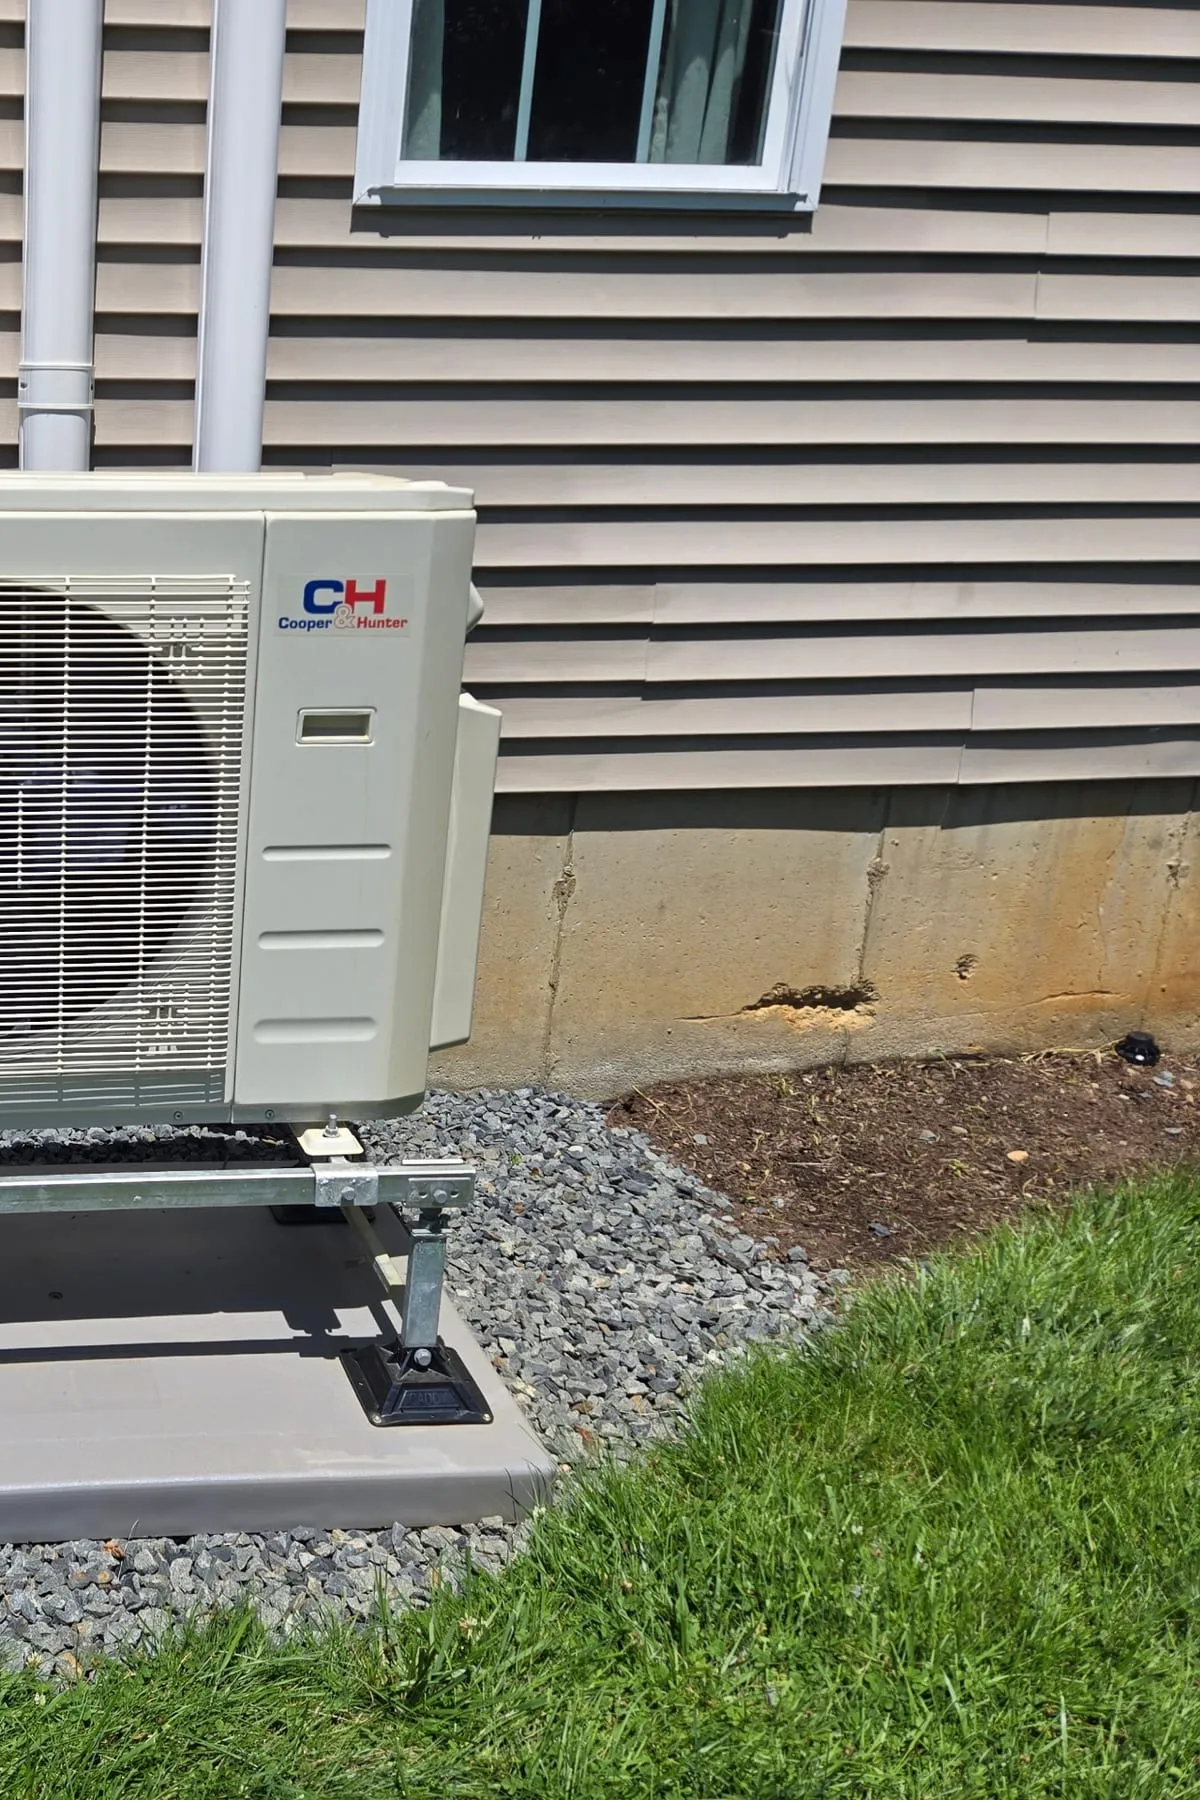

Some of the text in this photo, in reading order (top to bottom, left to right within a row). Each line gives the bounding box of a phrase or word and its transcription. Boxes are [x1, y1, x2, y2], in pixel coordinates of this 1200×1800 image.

[303, 579, 386, 614] CH
[278, 604, 408, 632] Cooper & Hunter
